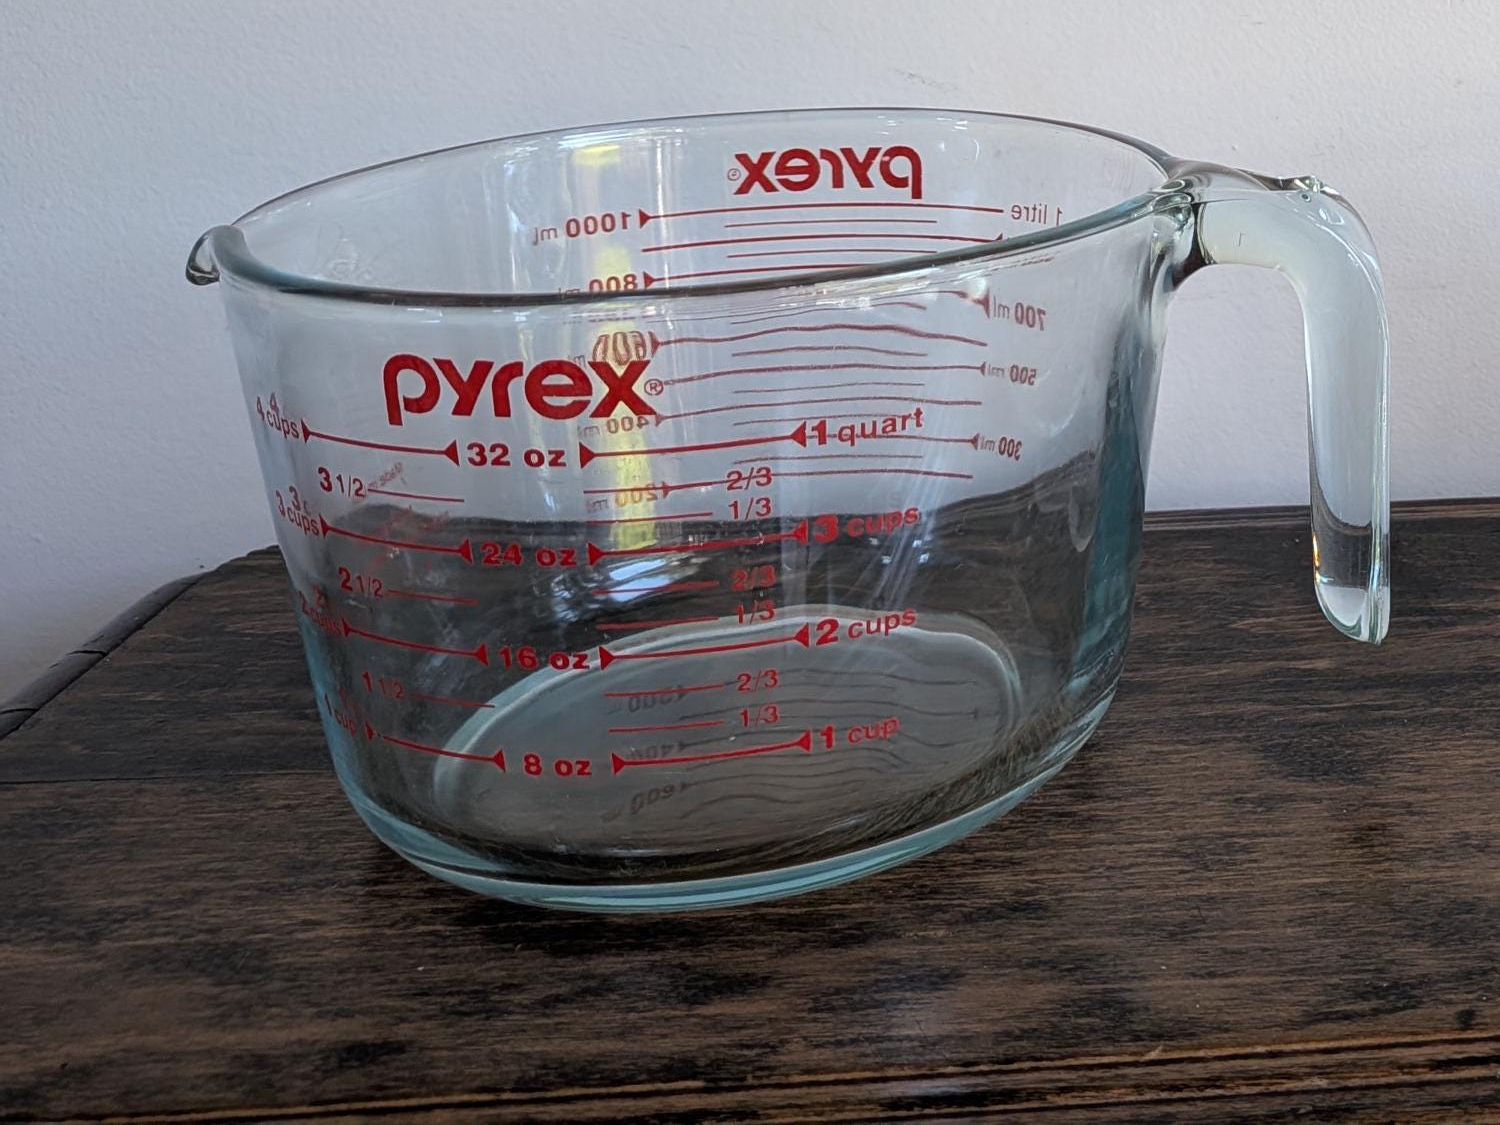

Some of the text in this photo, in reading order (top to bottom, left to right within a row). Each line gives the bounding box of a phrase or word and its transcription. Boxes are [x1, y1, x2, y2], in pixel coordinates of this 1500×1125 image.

[266, 410, 300, 441] cups
[811, 407, 924, 447] 1 quart
[466, 442, 567, 468] 32 oz
[726, 466, 773, 492] 2/3
[728, 496, 772, 522] 1/3
[813, 506, 921, 544] 3 cups
[480, 543, 577, 567] 24 oz
[730, 565, 776, 592] 2/3
[736, 600, 776, 625] 1/3
[816, 608, 918, 646] 2 cups
[498, 646, 589, 670] 16 oz
[737, 669, 779, 692] 2/3
[739, 704, 779, 728] 1/3
[819, 716, 900, 750] 1 cup
[522, 753, 592, 776] 8 oz
